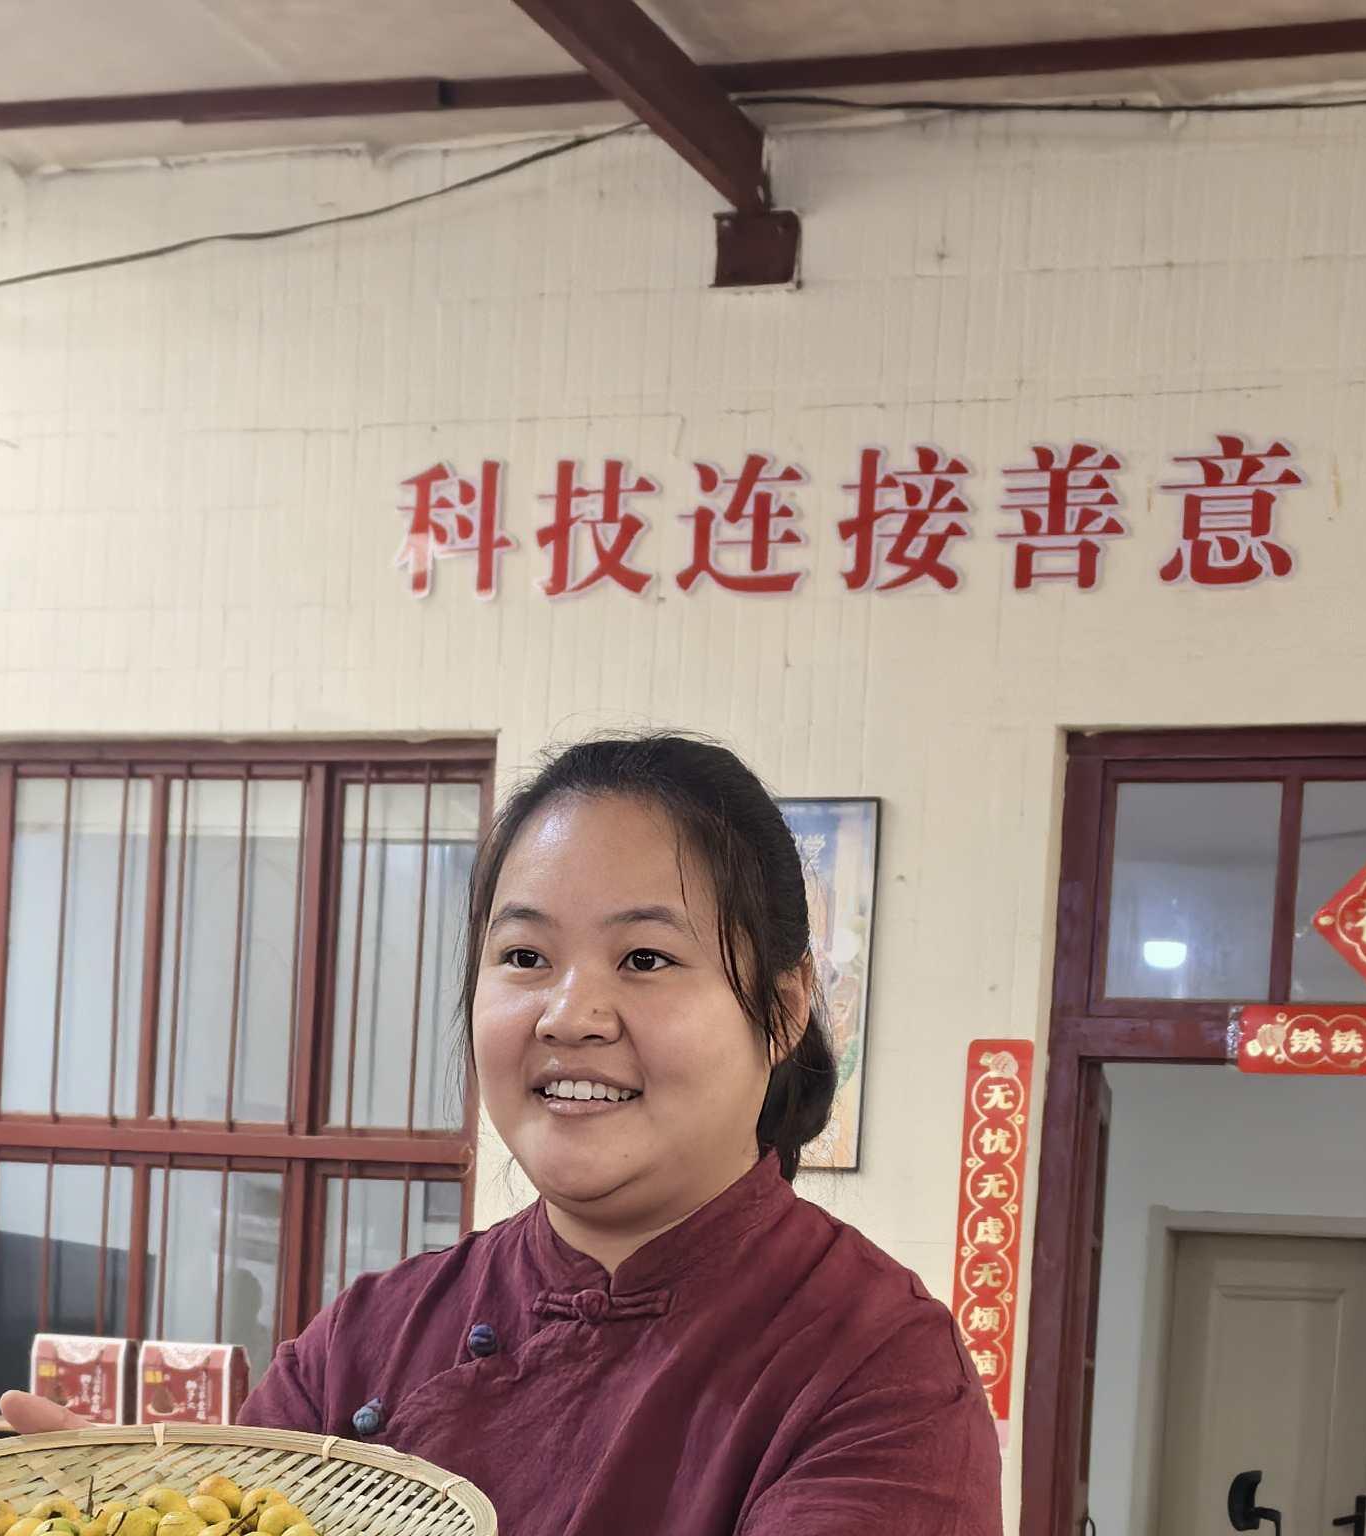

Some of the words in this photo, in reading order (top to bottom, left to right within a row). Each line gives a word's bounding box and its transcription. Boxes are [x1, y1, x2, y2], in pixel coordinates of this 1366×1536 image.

[396, 434, 1304, 597] 科技连接善意
